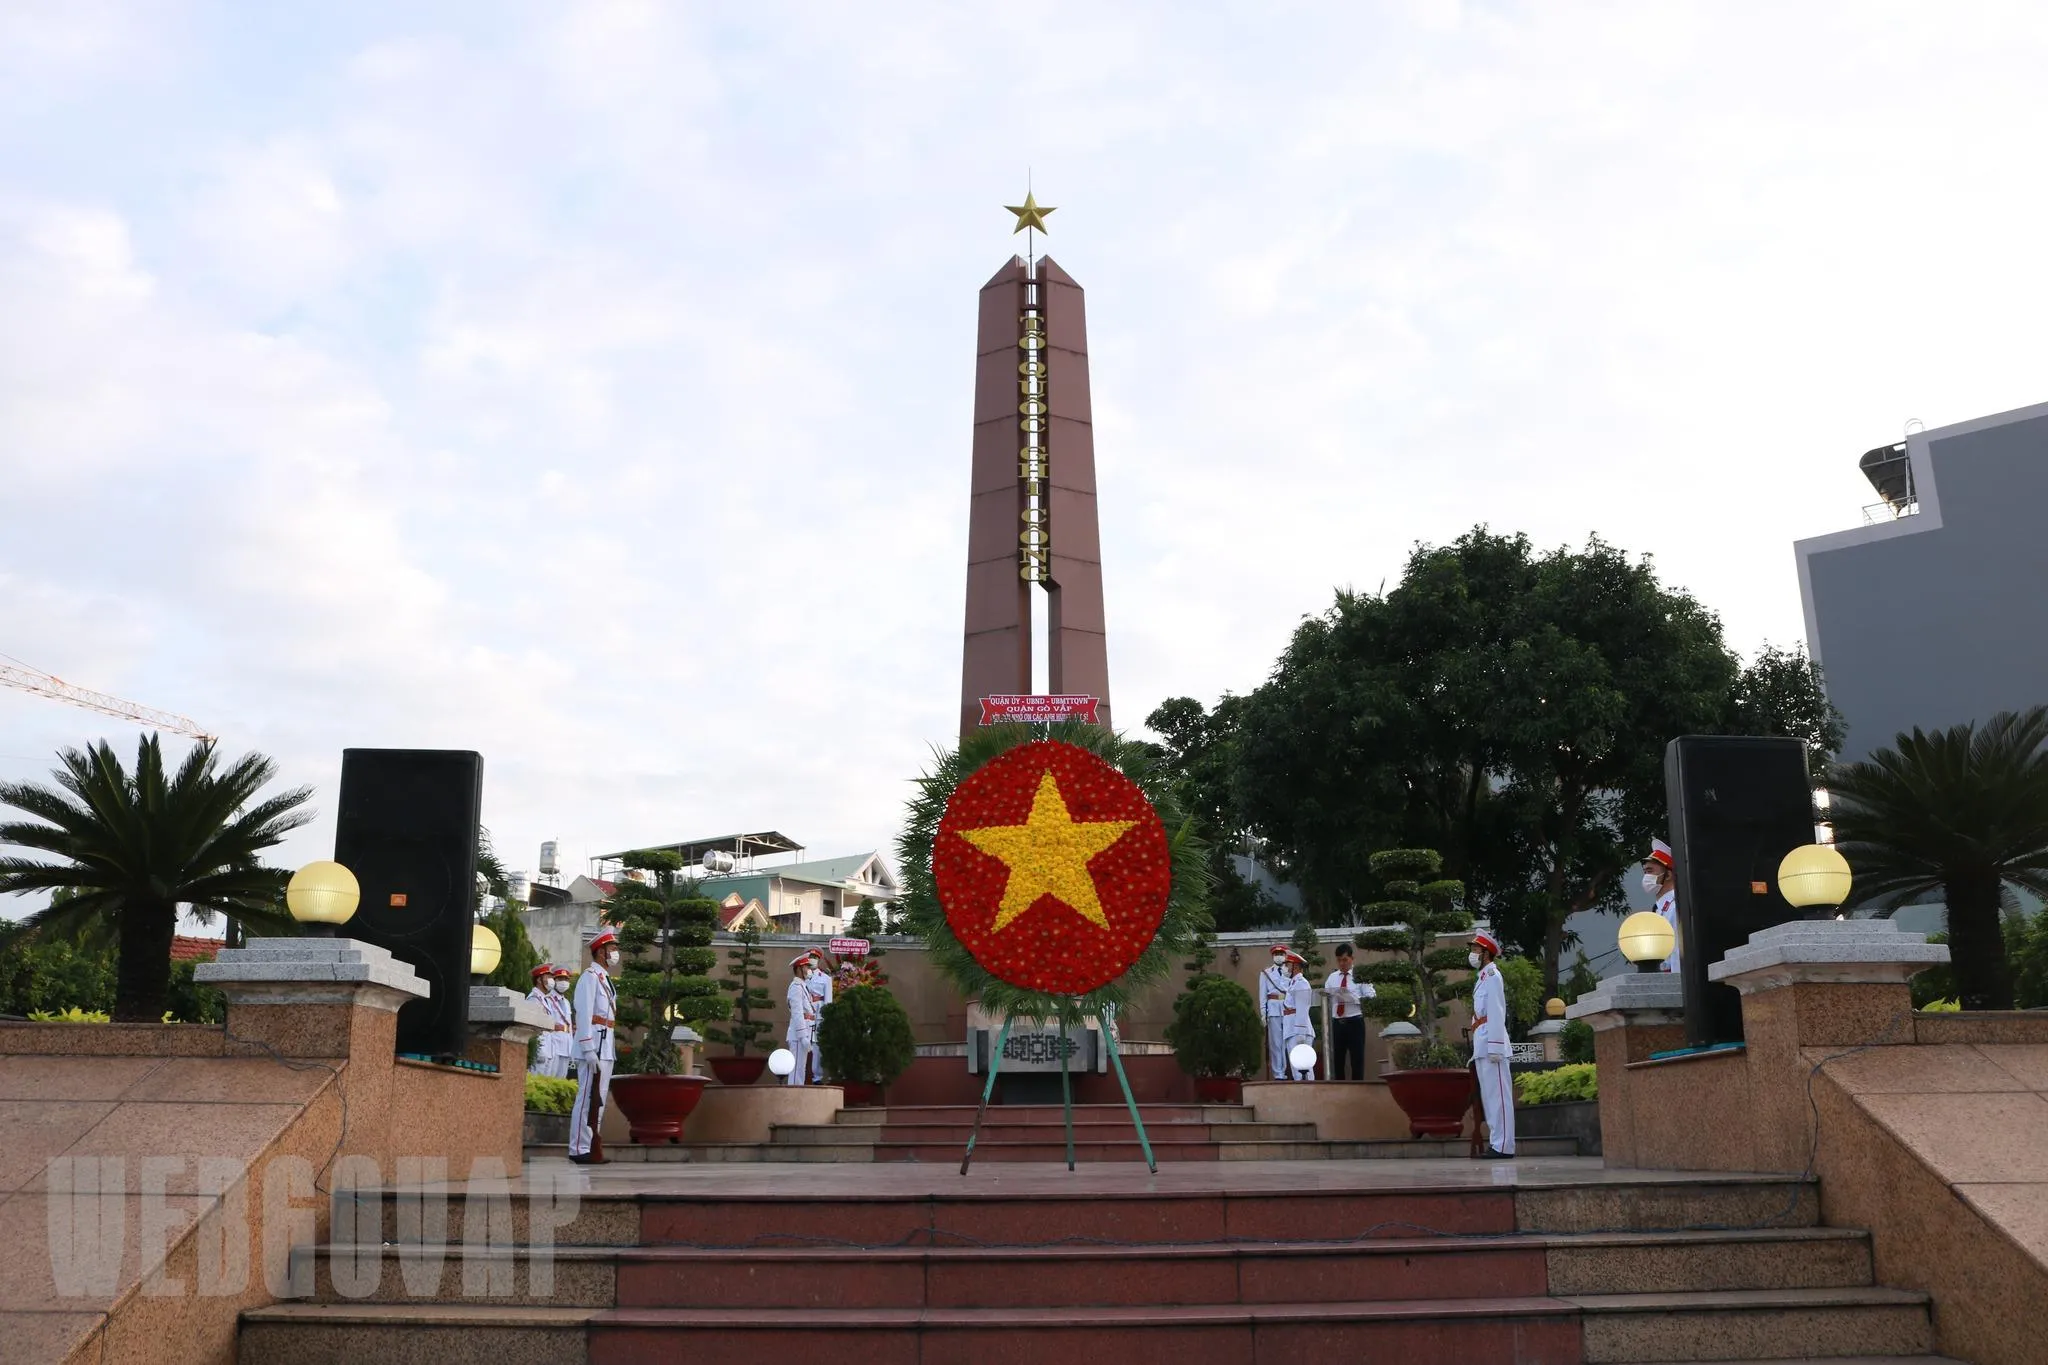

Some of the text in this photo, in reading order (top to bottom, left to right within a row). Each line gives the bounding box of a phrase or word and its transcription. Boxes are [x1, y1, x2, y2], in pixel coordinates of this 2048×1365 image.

[1018, 361, 1048, 433] QUỐC
[1018, 446, 1048, 496] GHI
[1019, 509, 1050, 582] CÔNG
[1006, 704, 1034, 713] QUẬN
[1036, 704, 1051, 712] GÒ
